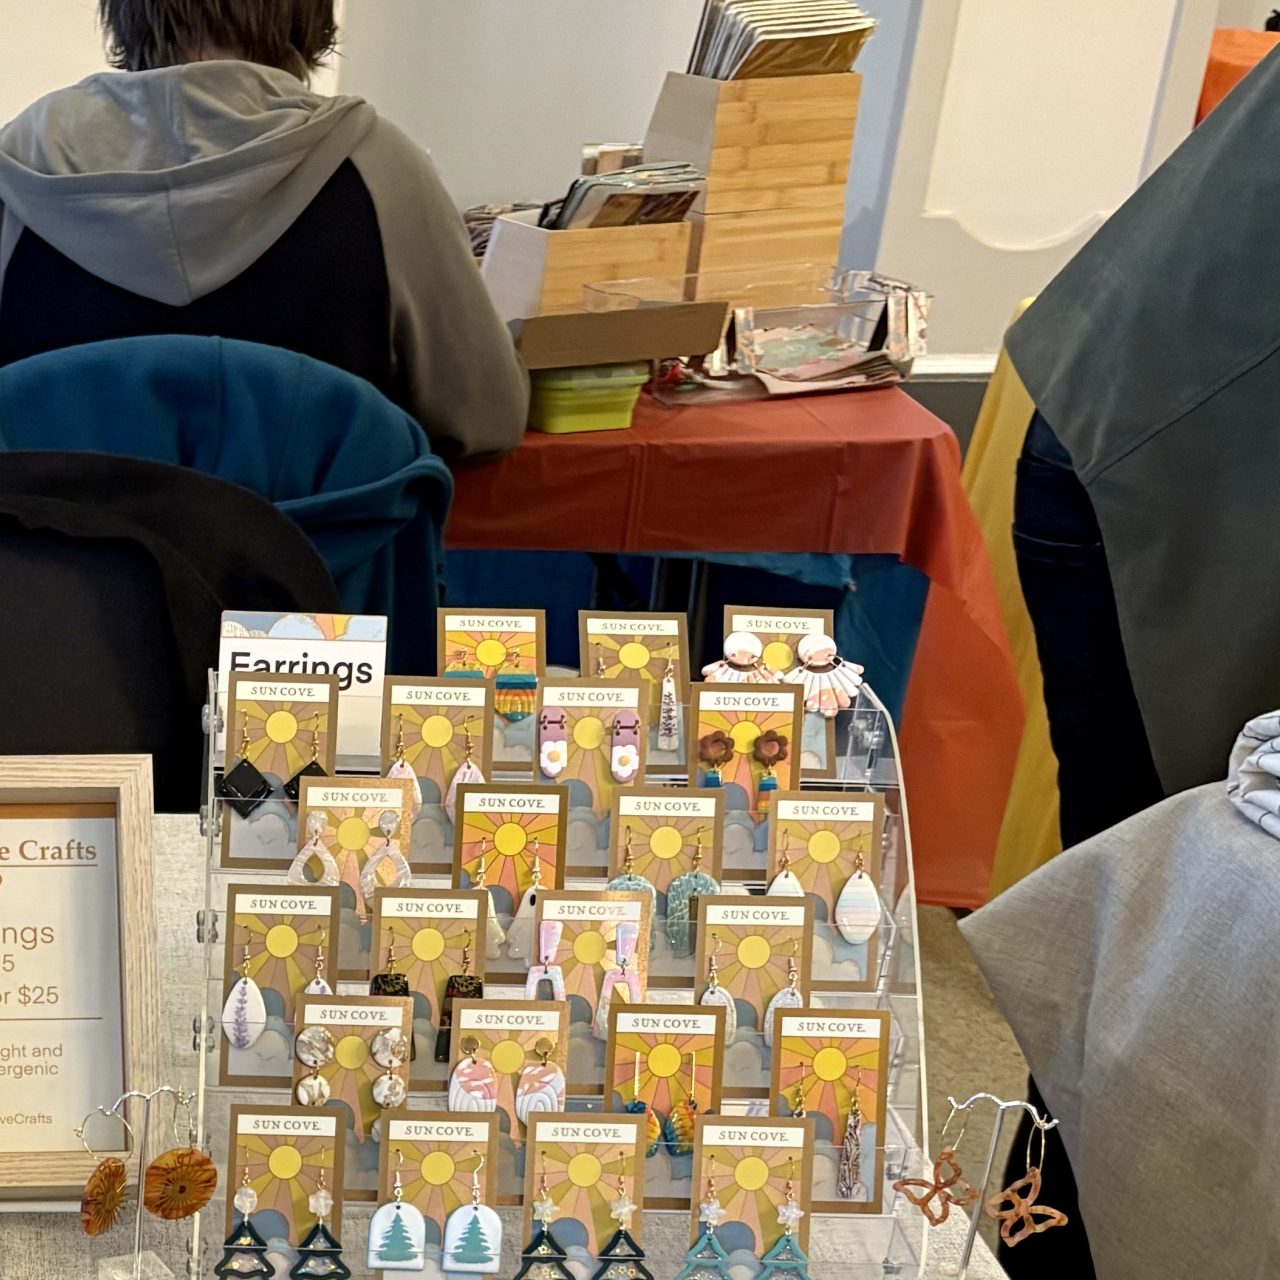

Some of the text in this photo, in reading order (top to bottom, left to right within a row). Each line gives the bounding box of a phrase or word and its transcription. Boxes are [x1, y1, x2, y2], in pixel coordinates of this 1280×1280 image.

[459, 619, 485, 627] SUN
[747, 620, 772, 628] SUN
[230, 651, 373, 691] Earrings
[251, 686, 315, 697] SUN COVE
[406, 690, 471, 701] SUN COVE
[558, 692, 624, 702] SUN COVE
[714, 696, 780, 707] SUN COVE
[322, 792, 350, 802] SUN
[478, 798, 545, 808] SUN COVE
[634, 801, 701, 812] SUN COVE
[793, 805, 859, 816] SUN COVE
[19, 839, 97, 861] Crafts
[250, 899, 317, 910] SUN COVE
[396, 903, 464, 913] SUN COVE
[558, 905, 586, 915] SUN
[721, 910, 790, 920] SUN COVE
[17, 984, 59, 1007] $25
[320, 1009, 387, 1021] SUN COVE
[475, 1014, 544, 1025] SUN COVE
[632, 1018, 701, 1029] SUN COVE
[797, 1022, 866, 1032] SUN COVE
[32, 1043, 63, 1058] and
[253, 1120, 321, 1131] SUN COVE
[404, 1125, 474, 1136] SUN COVE
[552, 1127, 621, 1138] SUN COVE
[718, 1130, 789, 1142] SUN COVE
